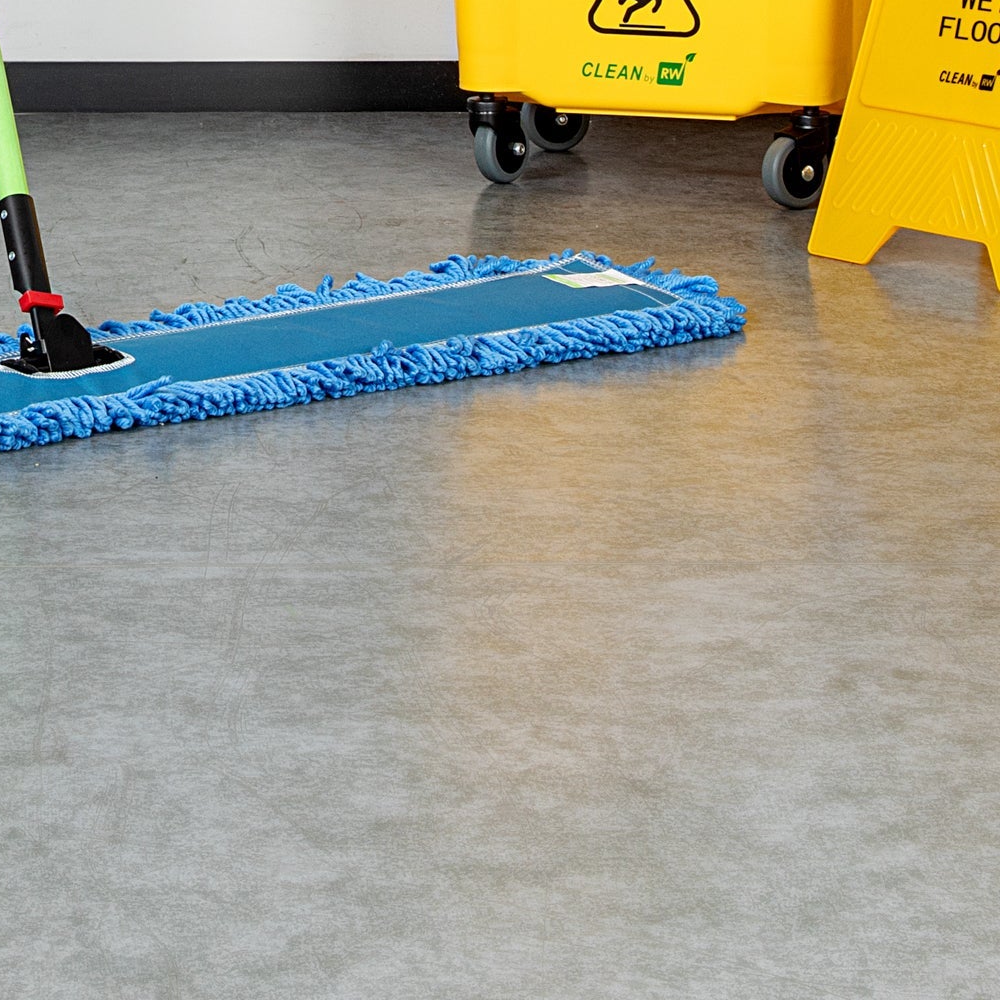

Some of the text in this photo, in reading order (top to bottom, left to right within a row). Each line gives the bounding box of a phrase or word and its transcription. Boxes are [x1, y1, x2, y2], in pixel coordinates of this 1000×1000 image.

[582, 62, 683, 84] CLEAN by RW
[939, 70, 995, 88] CLEAN by RW
